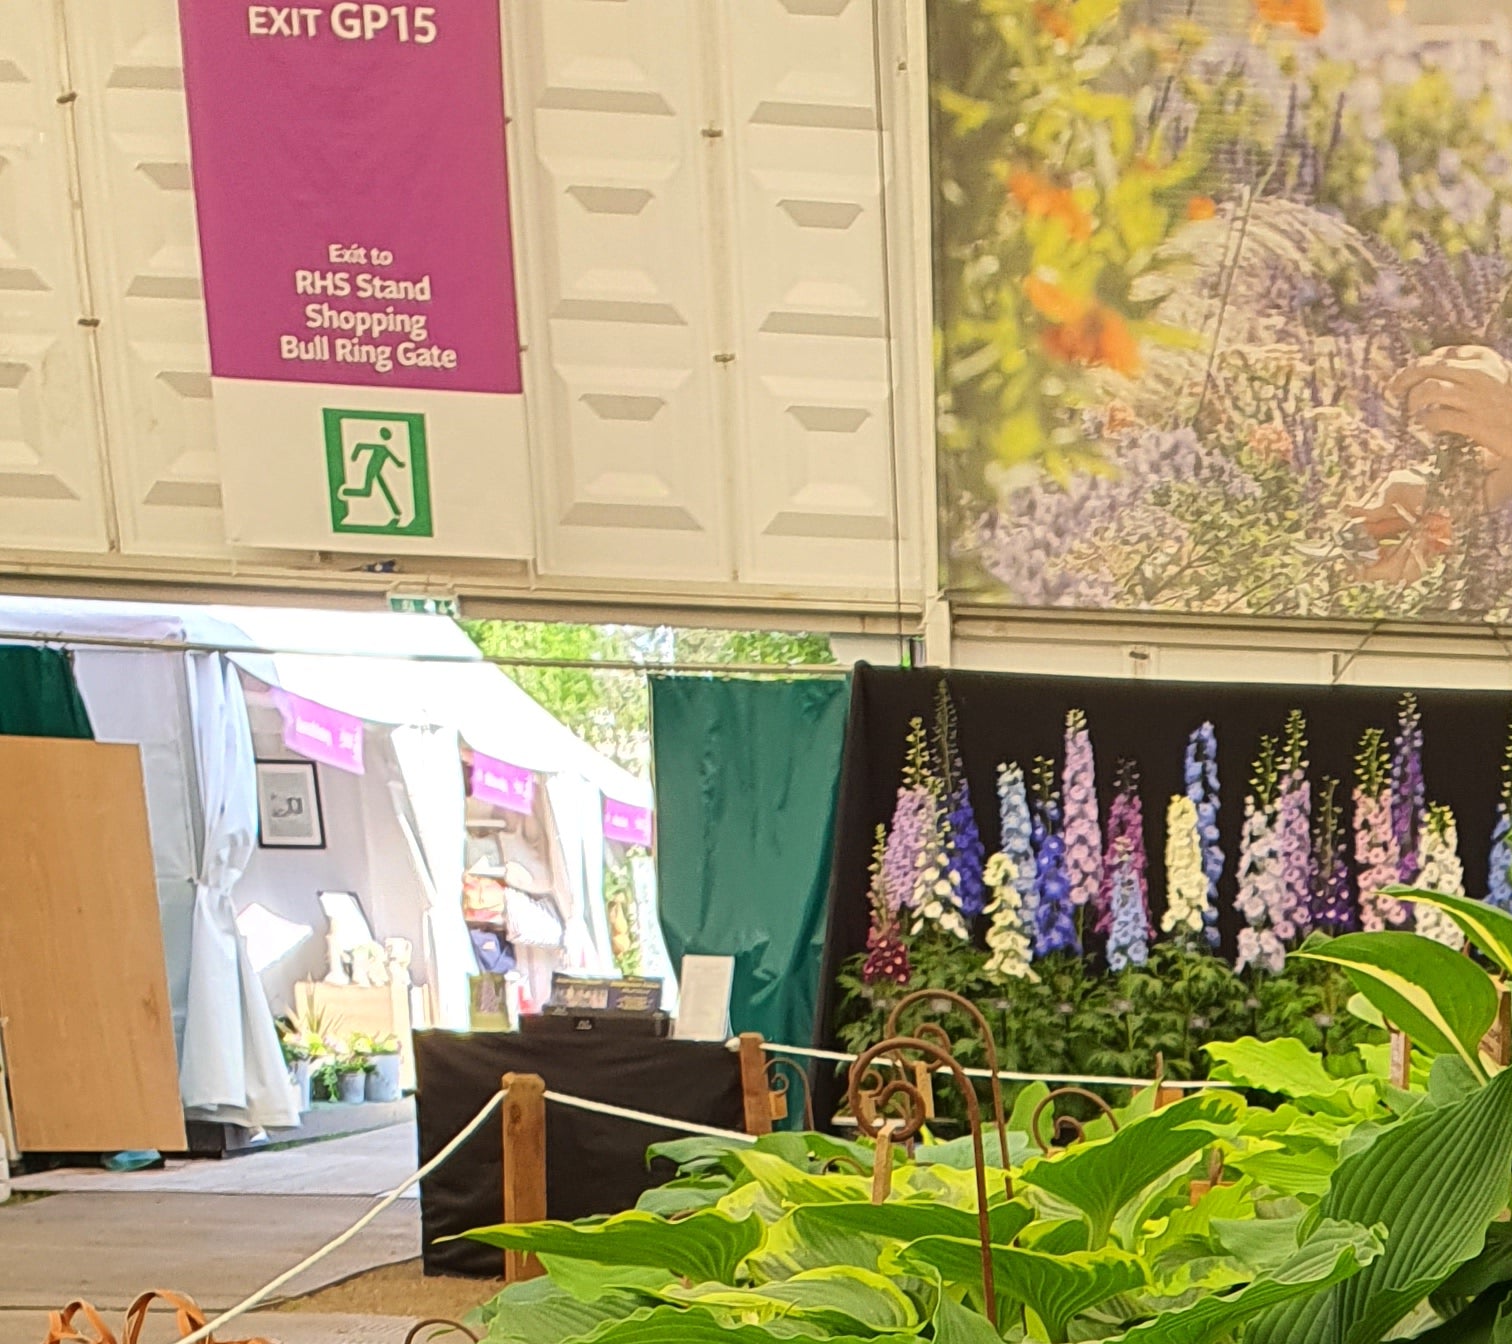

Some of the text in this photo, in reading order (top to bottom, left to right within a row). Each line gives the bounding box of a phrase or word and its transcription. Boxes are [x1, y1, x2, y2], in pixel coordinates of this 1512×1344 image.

[248, 2, 437, 43] EXIT GP15
[328, 244, 393, 265] Exit to
[295, 270, 431, 301] RHS Stand
[305, 302, 428, 341] Shopping
[280, 335, 457, 373] Bull Ring Gate
